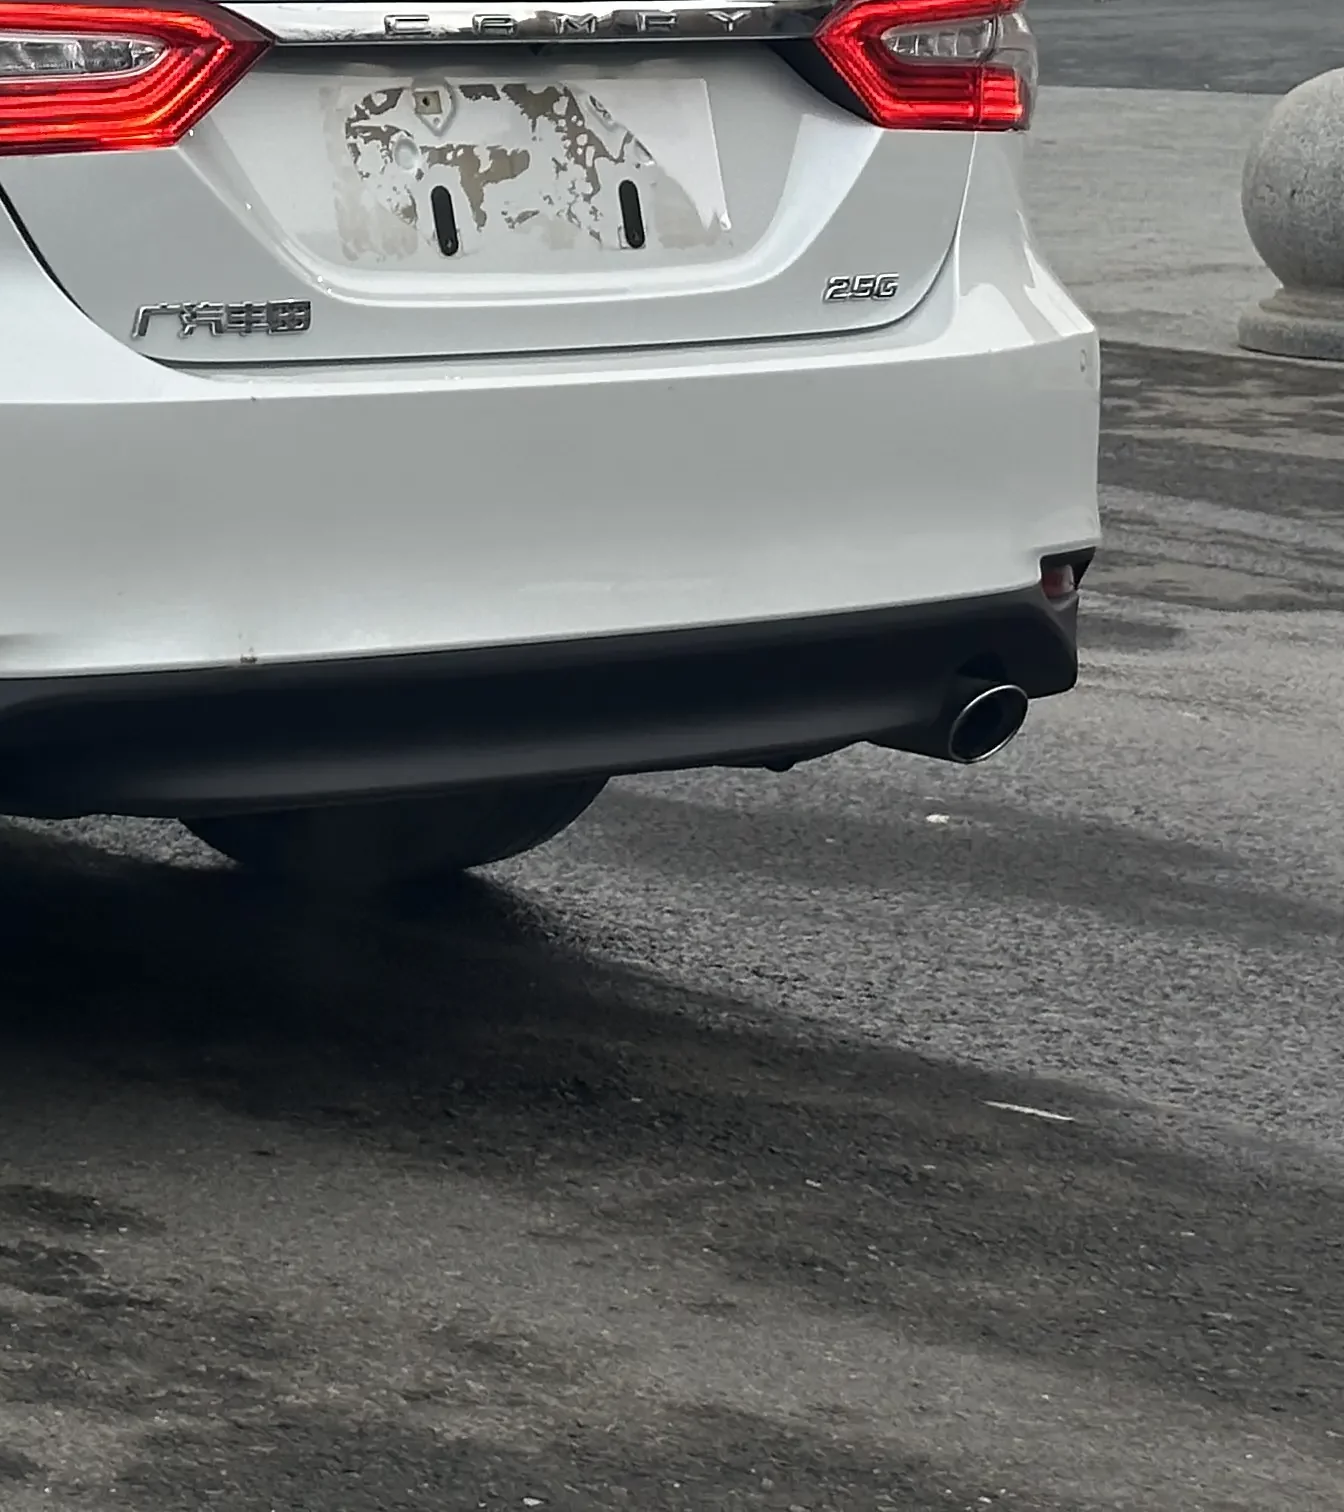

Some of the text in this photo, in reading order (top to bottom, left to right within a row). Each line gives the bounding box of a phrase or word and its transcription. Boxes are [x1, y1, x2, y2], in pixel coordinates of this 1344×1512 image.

[383, 8, 752, 36] CAMRY
[822, 272, 900, 302] 25G
[131, 299, 312, 338] 广汽丰田
